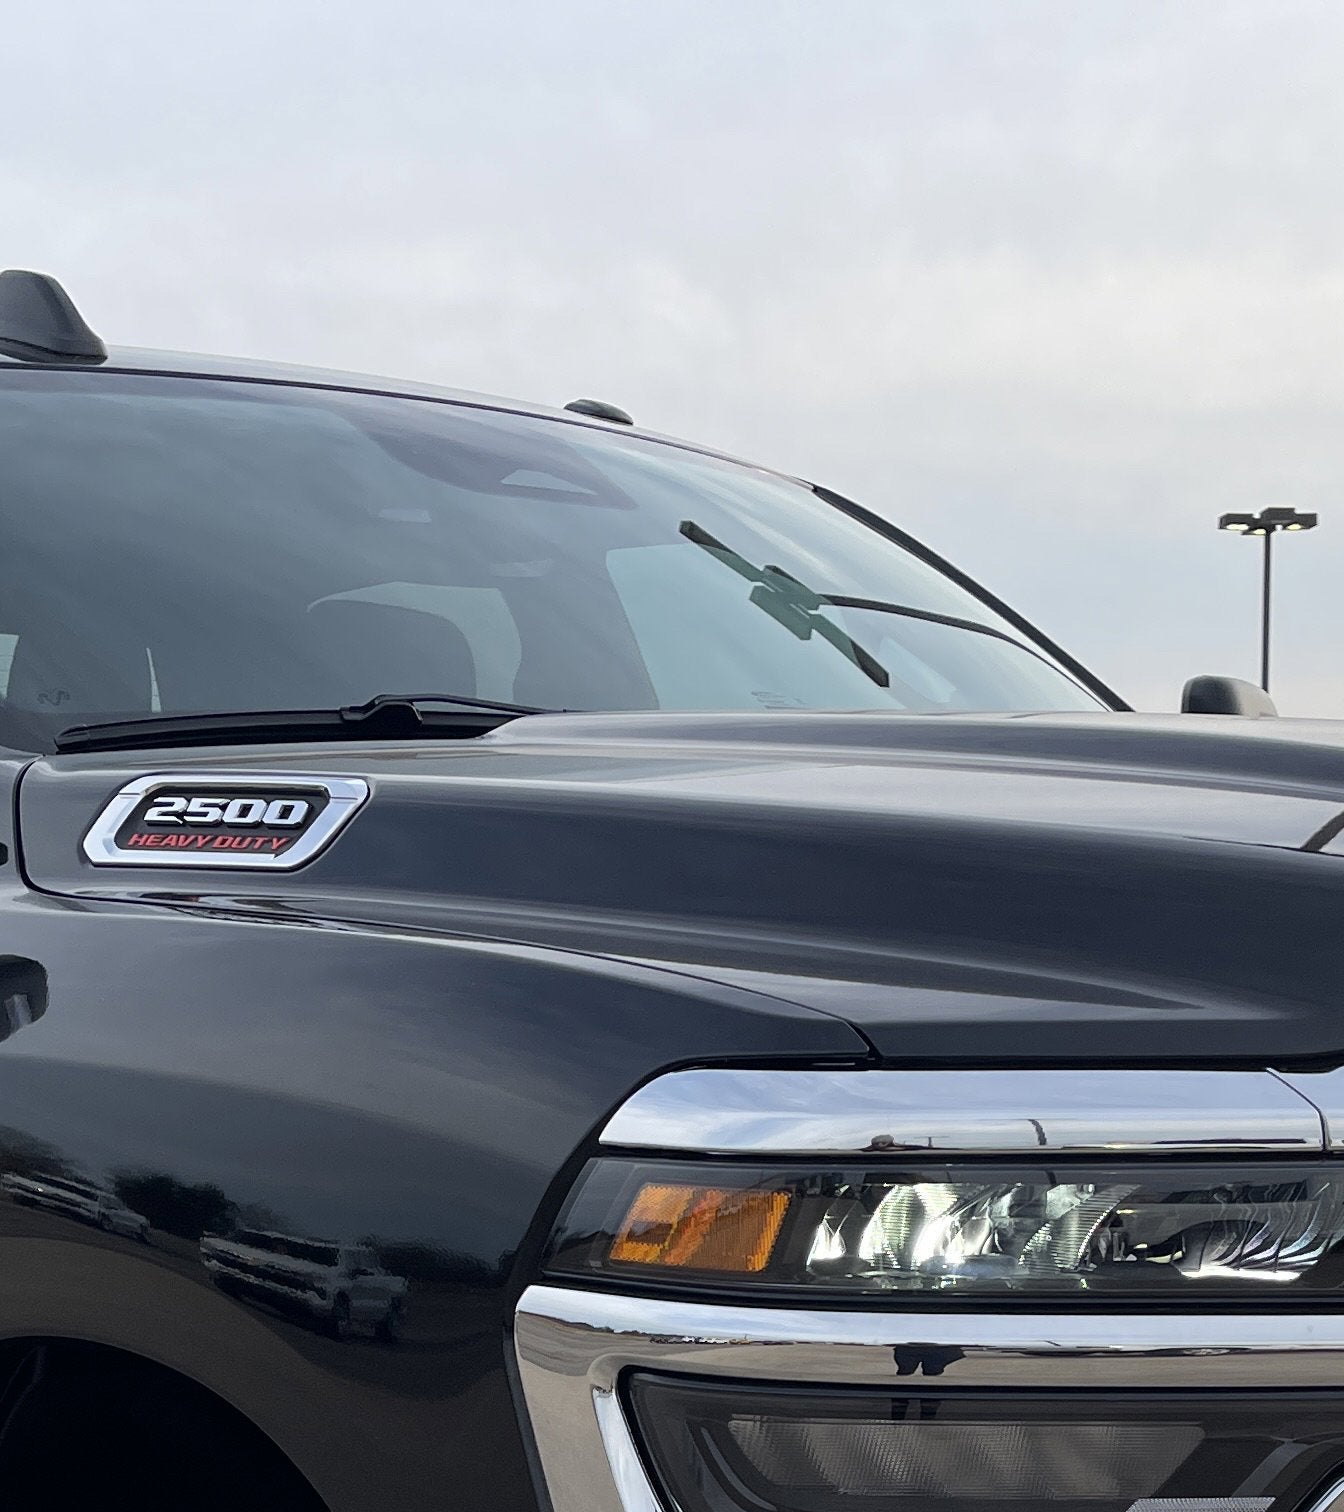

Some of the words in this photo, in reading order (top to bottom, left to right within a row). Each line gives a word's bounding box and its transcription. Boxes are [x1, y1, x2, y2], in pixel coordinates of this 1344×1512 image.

[143, 795, 309, 828] 2500
[127, 832, 212, 850] HEAVY
[212, 835, 291, 850] DUTY
